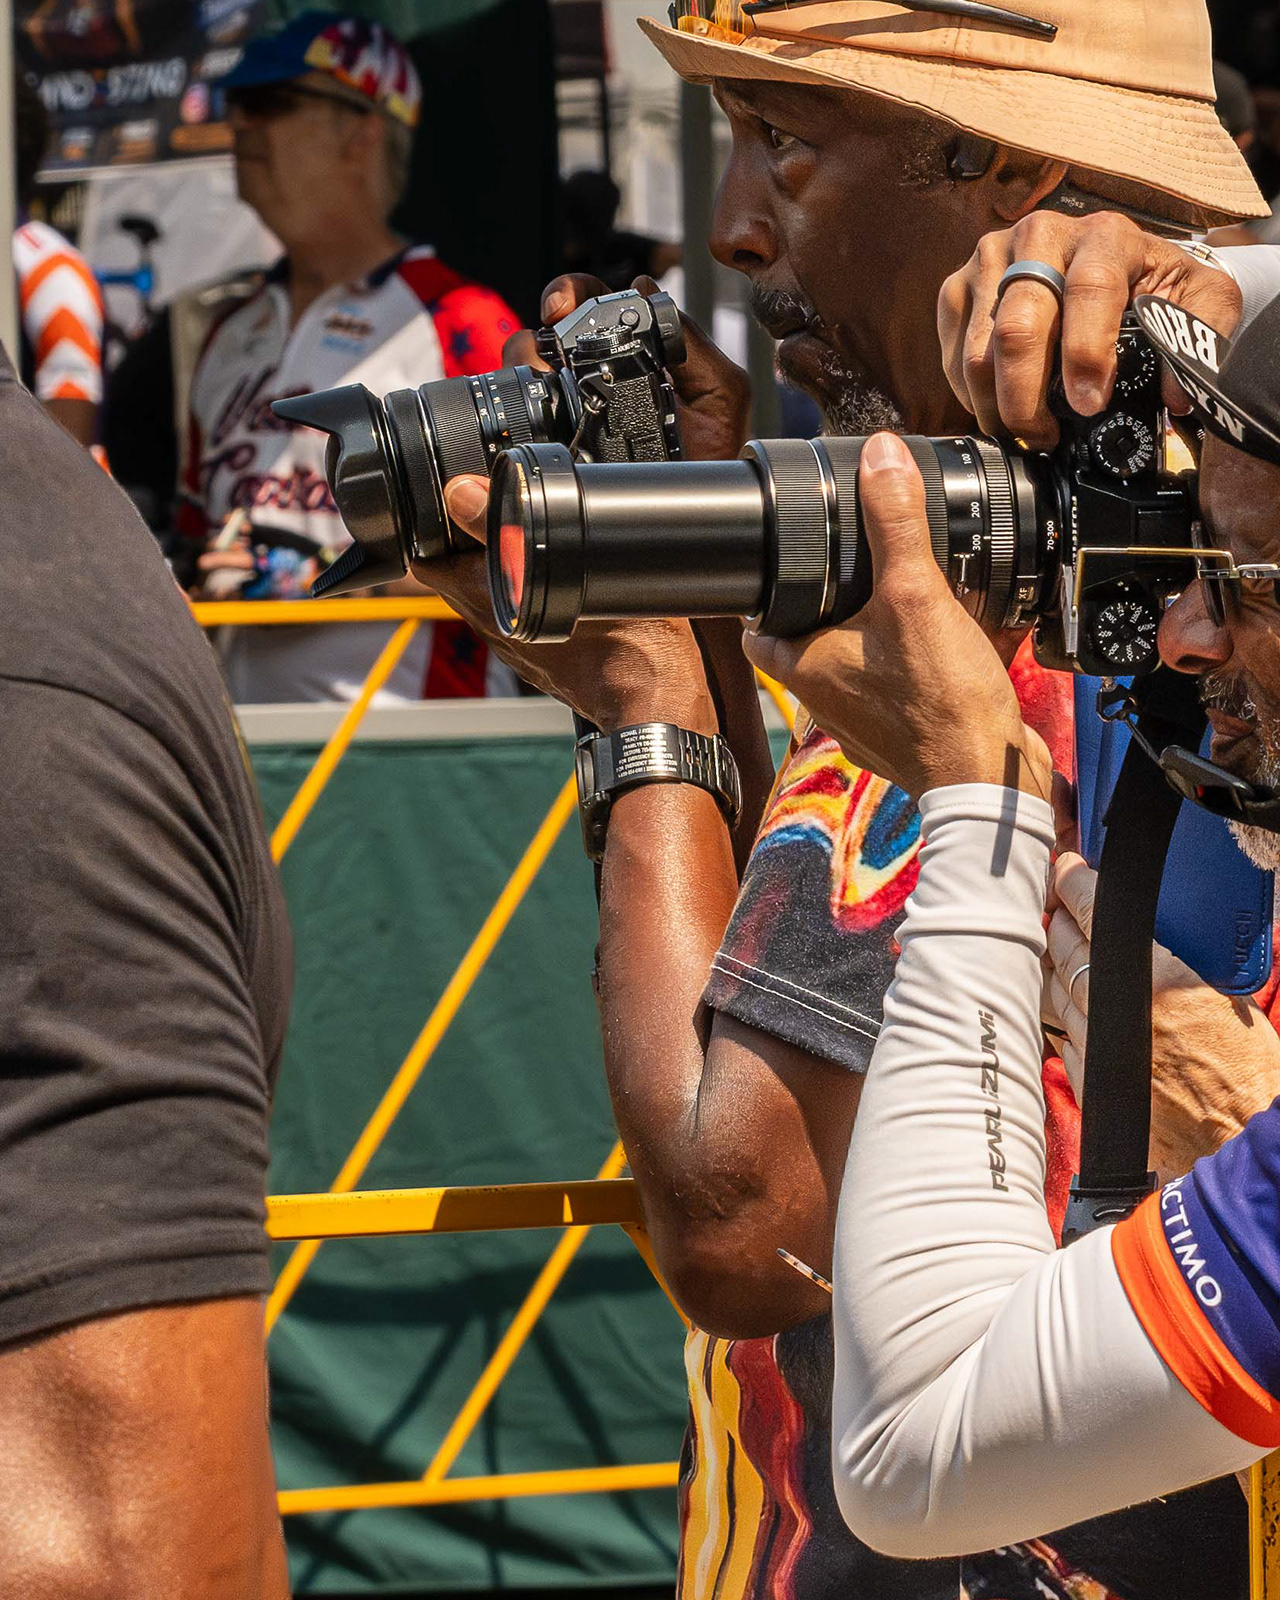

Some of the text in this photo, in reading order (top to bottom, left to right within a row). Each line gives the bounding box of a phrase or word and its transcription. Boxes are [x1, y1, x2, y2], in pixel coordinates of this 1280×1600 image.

[971, 501, 980, 518] 200
[972, 534, 981, 551] 300
[1046, 519, 1055, 551] 70-300
[1161, 1174, 1222, 1307] ACTIMO
